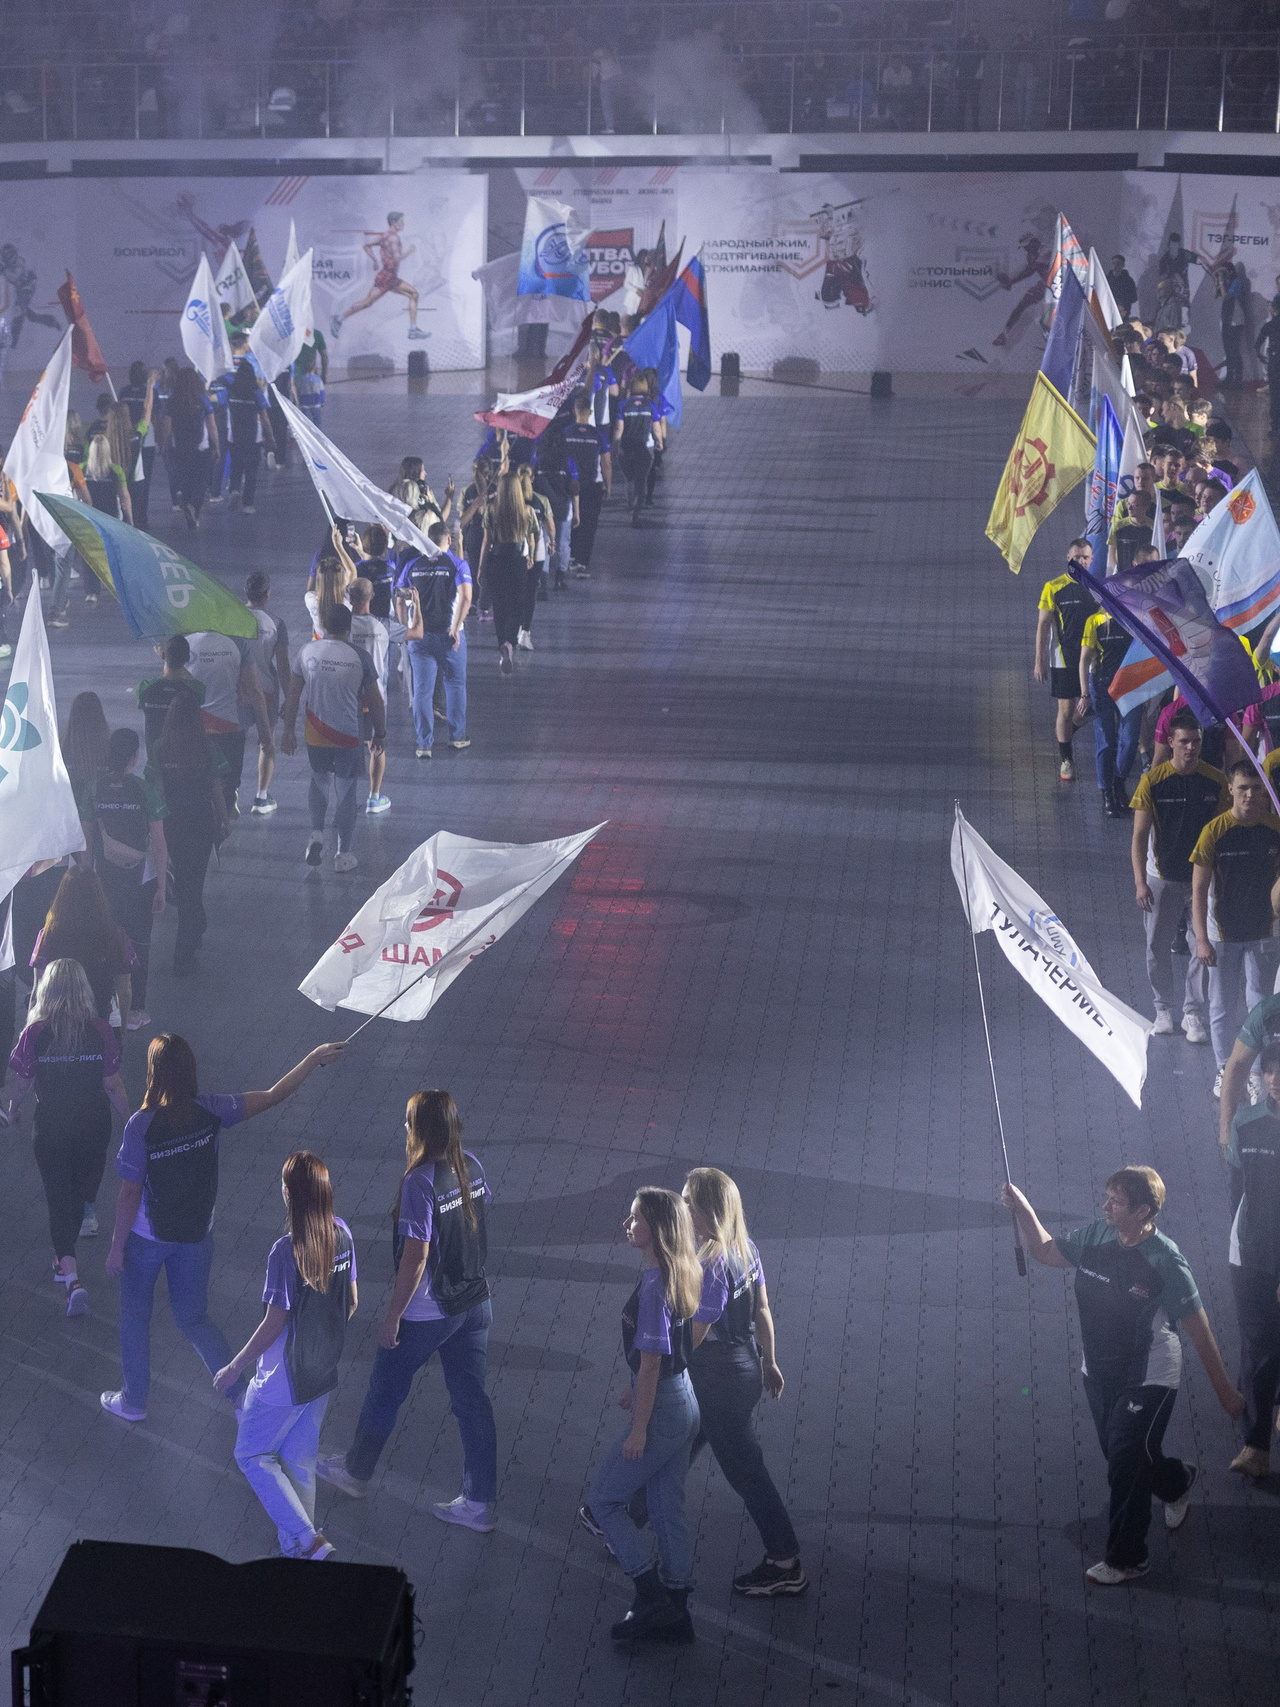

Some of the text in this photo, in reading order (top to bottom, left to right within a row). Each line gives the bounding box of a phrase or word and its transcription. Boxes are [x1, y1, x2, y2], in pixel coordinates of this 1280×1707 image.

[703, 238, 811, 249] НАРОДНЫЙ ЖИМ,
[1207, 233, 1269, 246] ТЭГ-РЕГБИ
[114, 246, 186, 257] ВОЛЕЙБОЛ
[704, 252, 804, 262] ПОДТЯГИВАНИЕ,
[704, 264, 783, 273] ОТЖИМАНИЕ
[322, 660, 355, 668] ПРОМСОРТ
[38, 1054, 103, 1063] БИЗНЕС-ЛИГА
[149, 1133, 214, 1160] БИЗНЕС-ЛИГ
